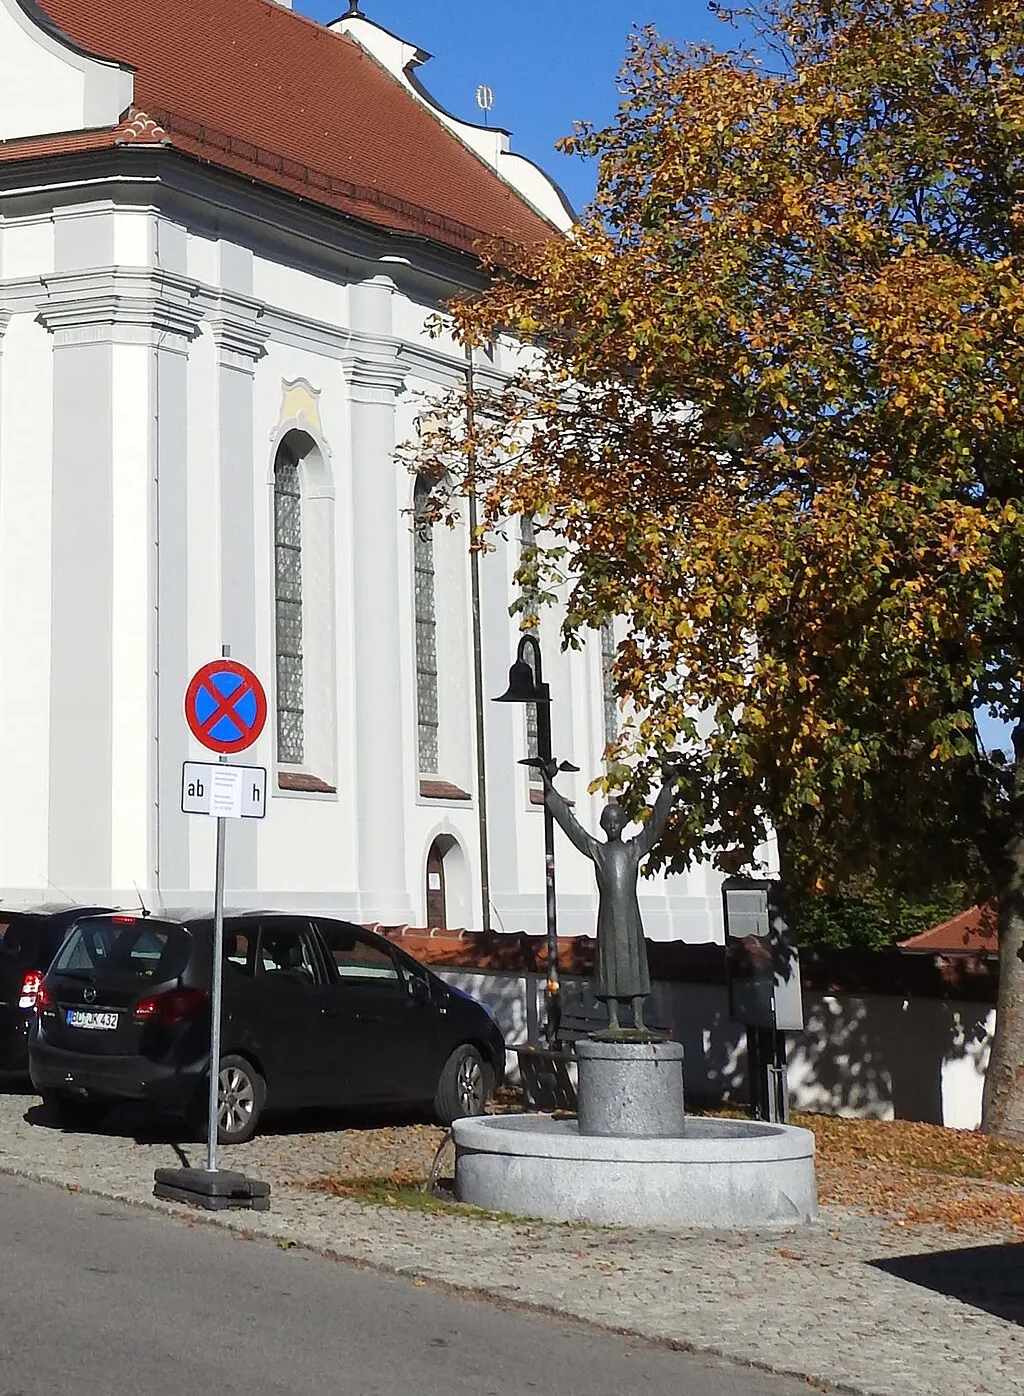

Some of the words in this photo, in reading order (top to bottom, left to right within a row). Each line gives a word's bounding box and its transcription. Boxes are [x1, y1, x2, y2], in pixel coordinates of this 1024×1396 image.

[188, 778, 204, 797] ab
[252, 783, 260, 802] h
[100, 1013, 117, 1027] 432
